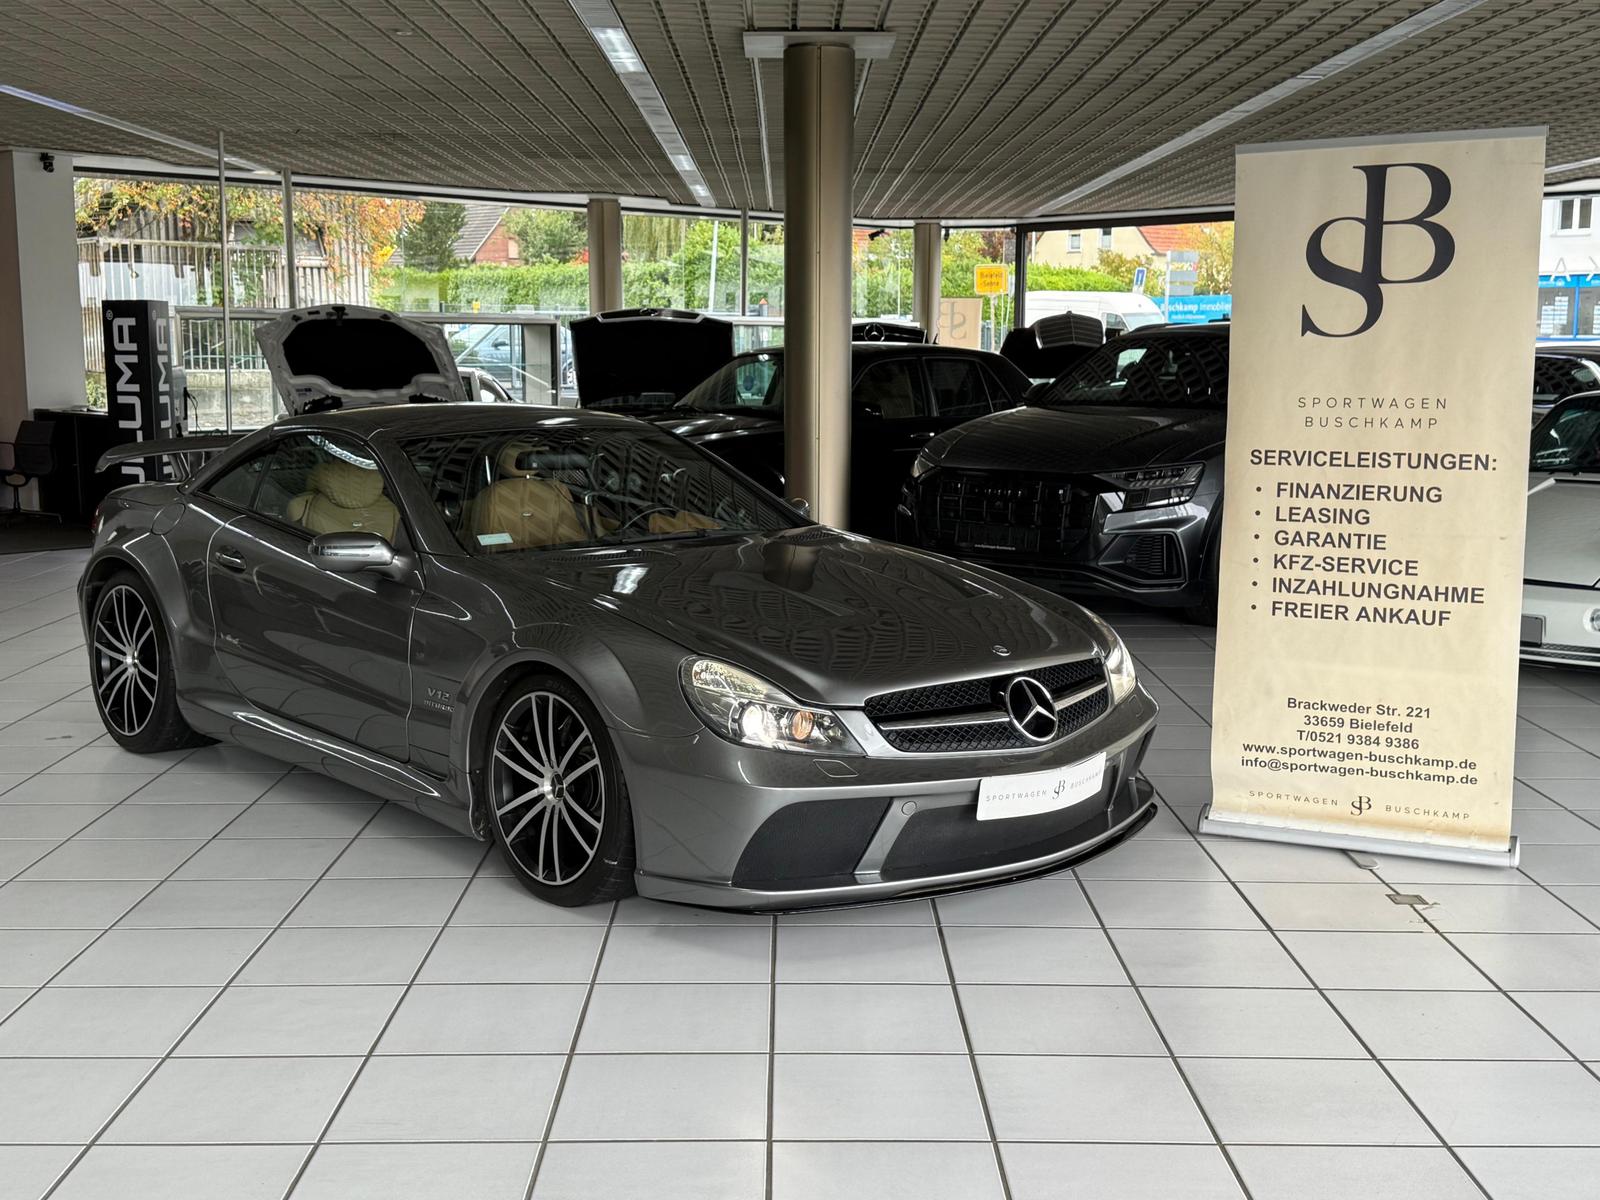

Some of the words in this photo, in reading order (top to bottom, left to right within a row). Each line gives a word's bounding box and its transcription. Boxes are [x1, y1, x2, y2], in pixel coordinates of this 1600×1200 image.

[1297, 397, 1448, 410] SPORTWAGEN
[1304, 416, 1438, 430] BUSCHKAMP
[1249, 449, 1497, 471] SERVICELEISTUNGEN:
[1276, 482, 1443, 503] FINANZIERUNG
[1275, 506, 1370, 525] LEASING
[1274, 530, 1387, 550] GARANTIE
[1273, 554, 1418, 576] KFZ-SERVICE
[1272, 577, 1485, 604] INZAHLUNGNAHME
[1271, 601, 1349, 622] FREIER
[1355, 606, 1451, 626] ANKAUF
[427, 687, 450, 701] V12
[1287, 697, 1372, 715] Brackweder
[1376, 704, 1401, 717] Str.
[1406, 706, 1431, 719] 221
[1303, 715, 1345, 729] 33659
[1349, 718, 1413, 734] Bielefeld
[1296, 730, 1341, 745] T/0521
[1347, 734, 1381, 748] 9384
[1385, 737, 1420, 751] 9386
[1242, 743, 1477, 770] www.sportwagen-buschkamp.de
[1241, 756, 1478, 786] info@sportwagen-buschkamp.de
[985, 790, 1047, 802] SPORTWAGEN
[1249, 790, 1339, 806] SPORTWAGEN
[1385, 804, 1471, 820] BUSCHKAMP
